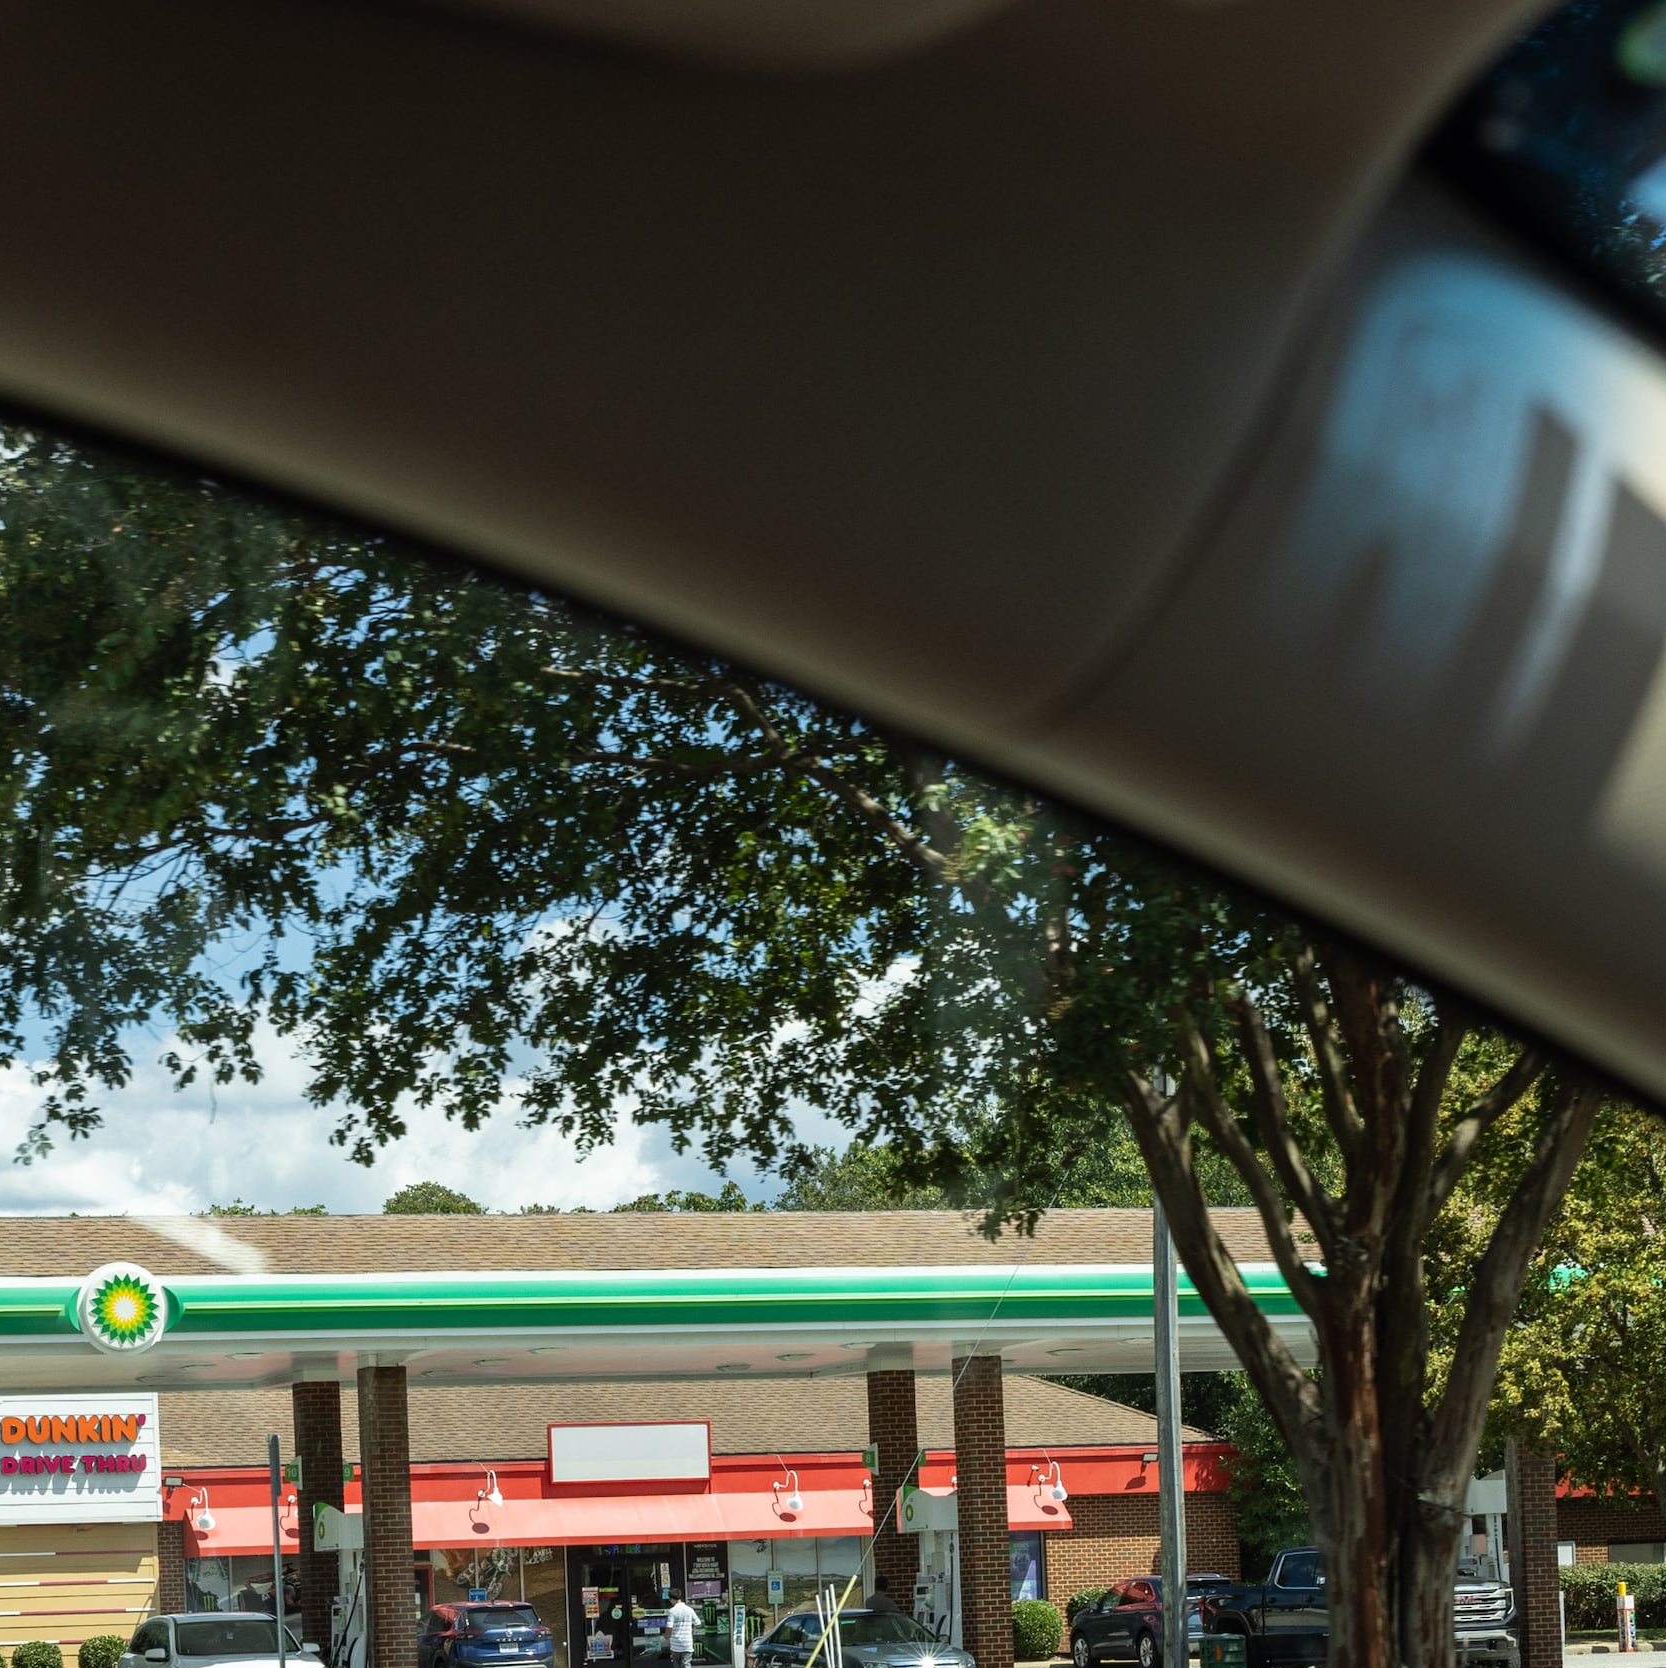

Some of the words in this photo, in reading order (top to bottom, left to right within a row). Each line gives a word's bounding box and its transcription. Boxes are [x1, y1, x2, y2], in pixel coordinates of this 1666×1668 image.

[0, 1413, 146, 1445] DUNKIN'
[0, 1455, 76, 1475] DRIVE
[81, 1453, 147, 1474] THRU
[344, 1467, 351, 1477] 9
[287, 1467, 298, 1478] 10
